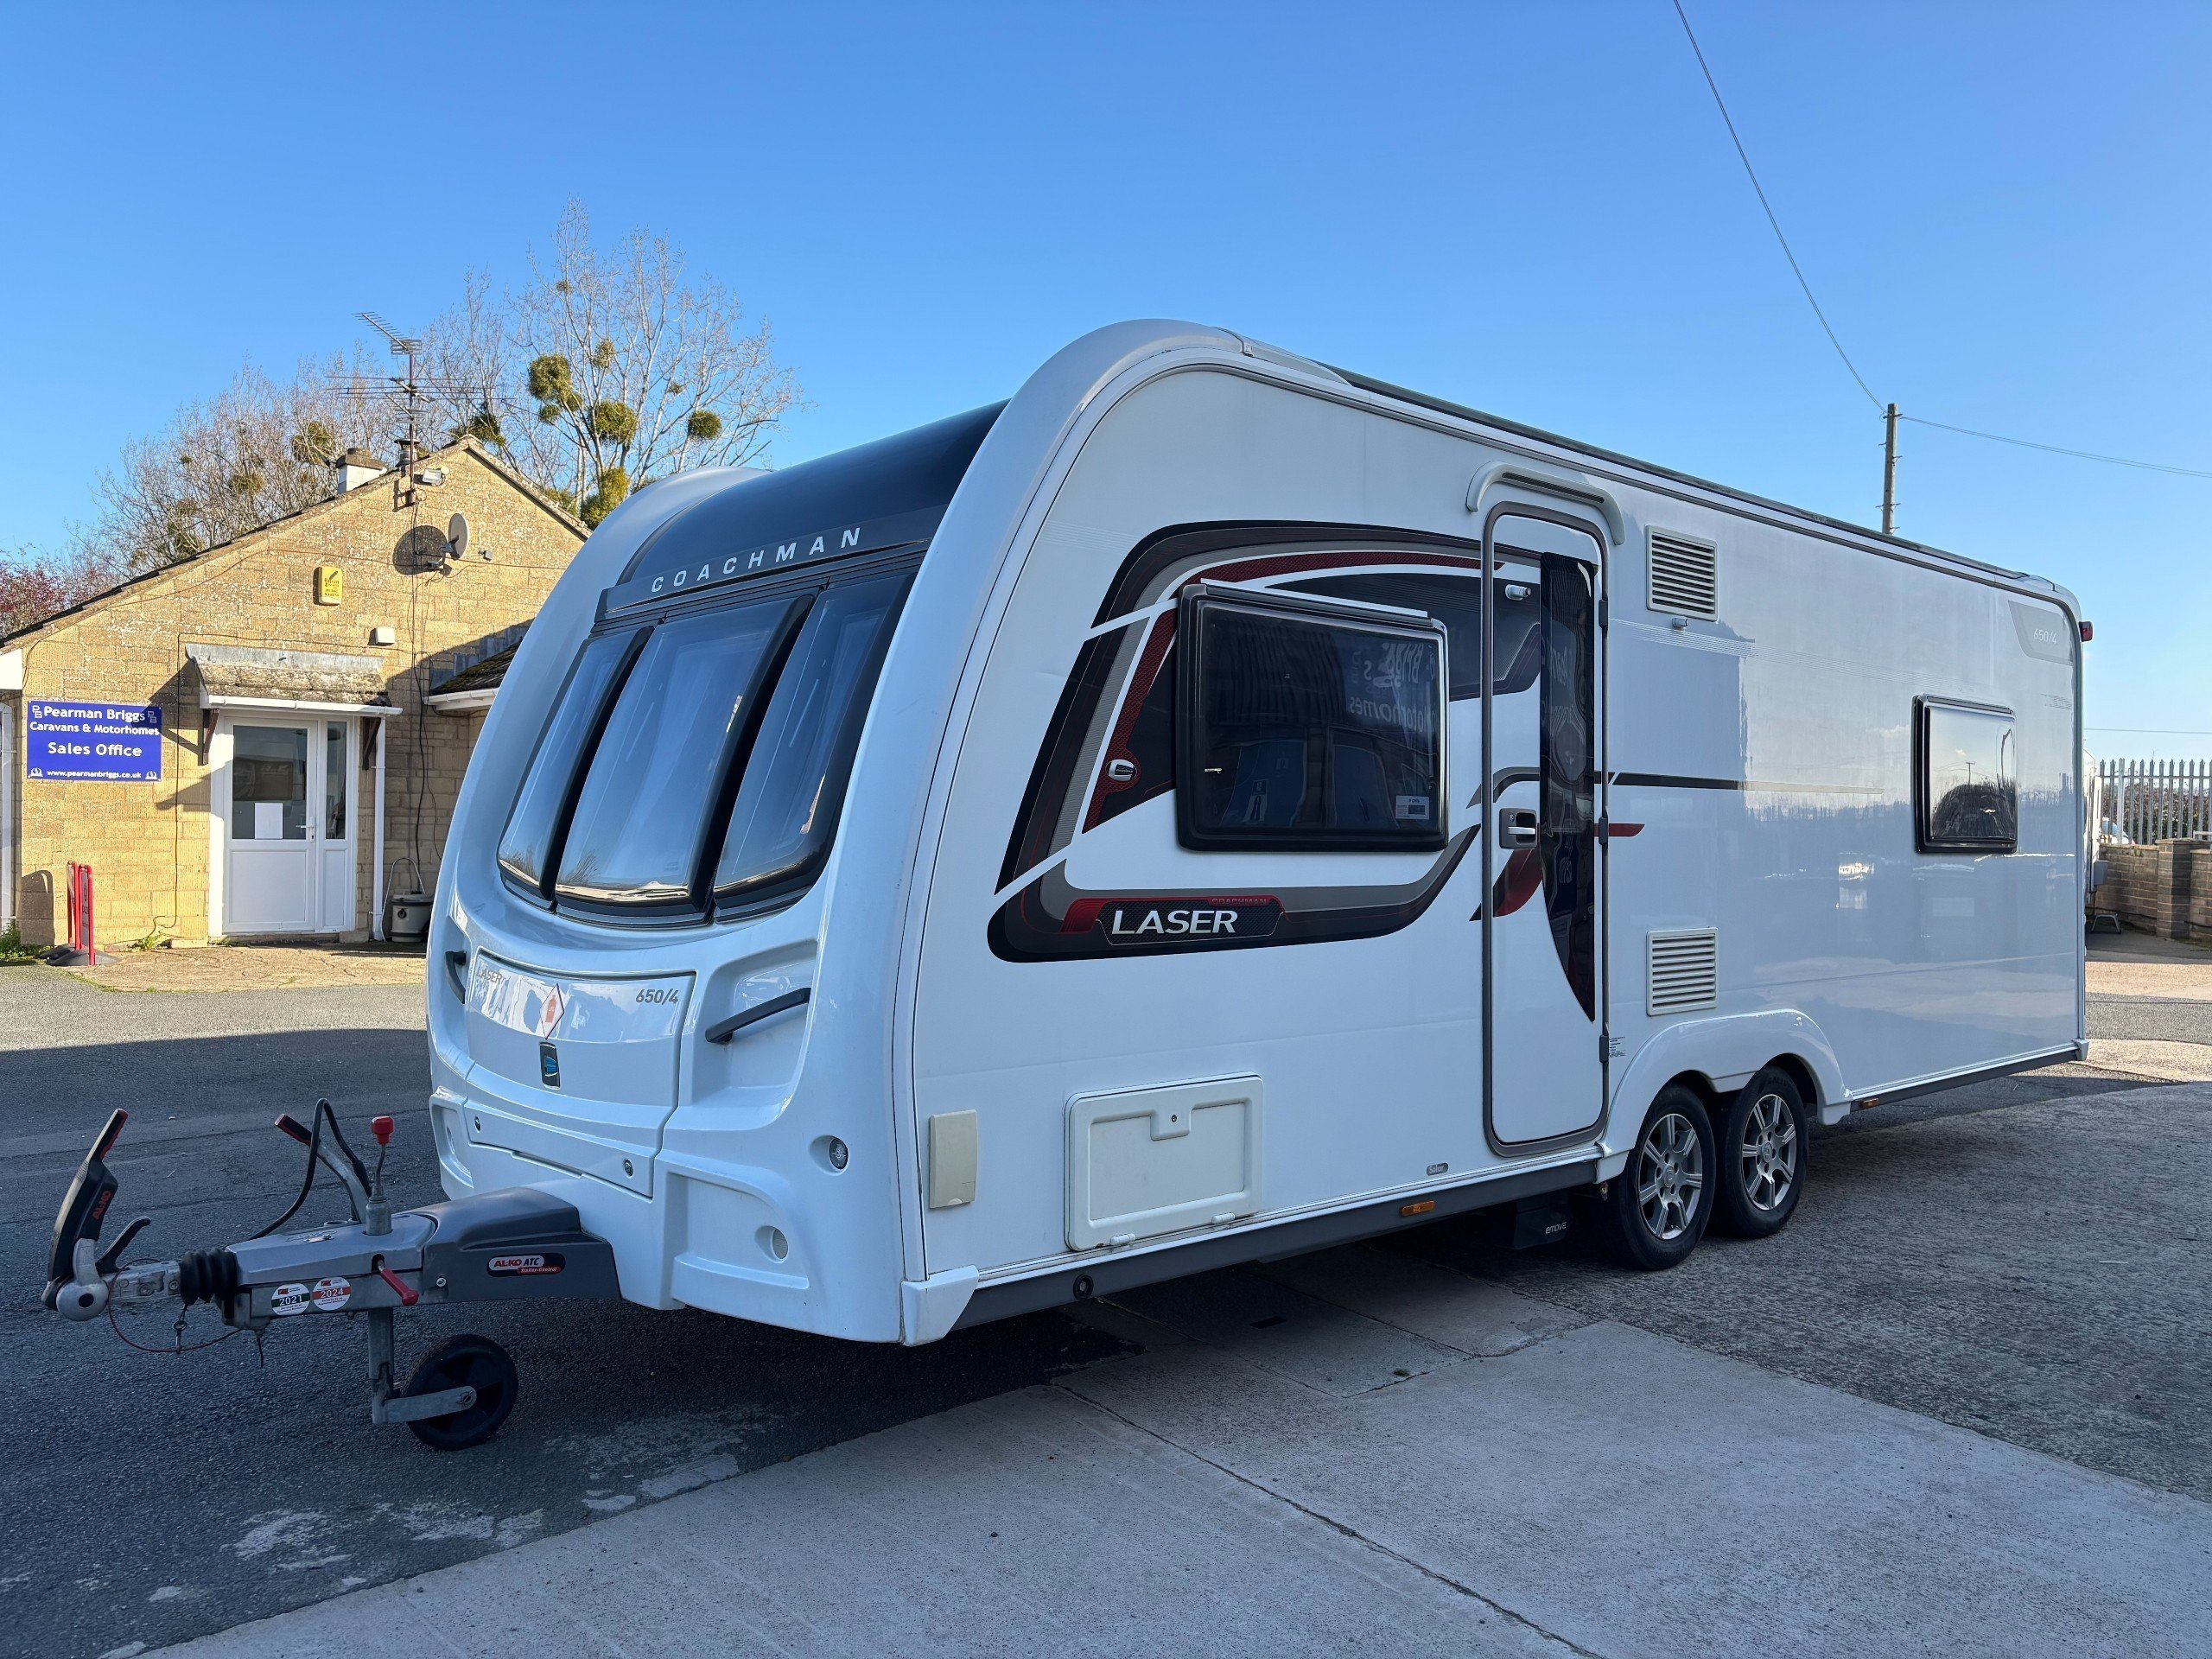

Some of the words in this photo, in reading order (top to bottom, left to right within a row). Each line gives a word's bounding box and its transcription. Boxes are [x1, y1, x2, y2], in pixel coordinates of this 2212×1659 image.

[651, 527, 861, 594] COACHMAN
[2033, 629, 2056, 644] 650/4
[44, 706, 102, 719] Pearman
[107, 709, 145, 723] Briggs
[30, 721, 79, 733] Caravans
[82, 723, 91, 733] &
[94, 724, 160, 735] Motorhomes
[48, 742, 91, 755] Sales
[96, 744, 143, 757] Office
[47, 770, 142, 779] www.pearmanbriggs.co.uk
[1111, 910, 1238, 935] LASER
[635, 988, 679, 1006] 650/4
[524, 1257, 540, 1267] ATC
[279, 1295, 302, 1306] 2021
[321, 1288, 344, 1299] 2024
